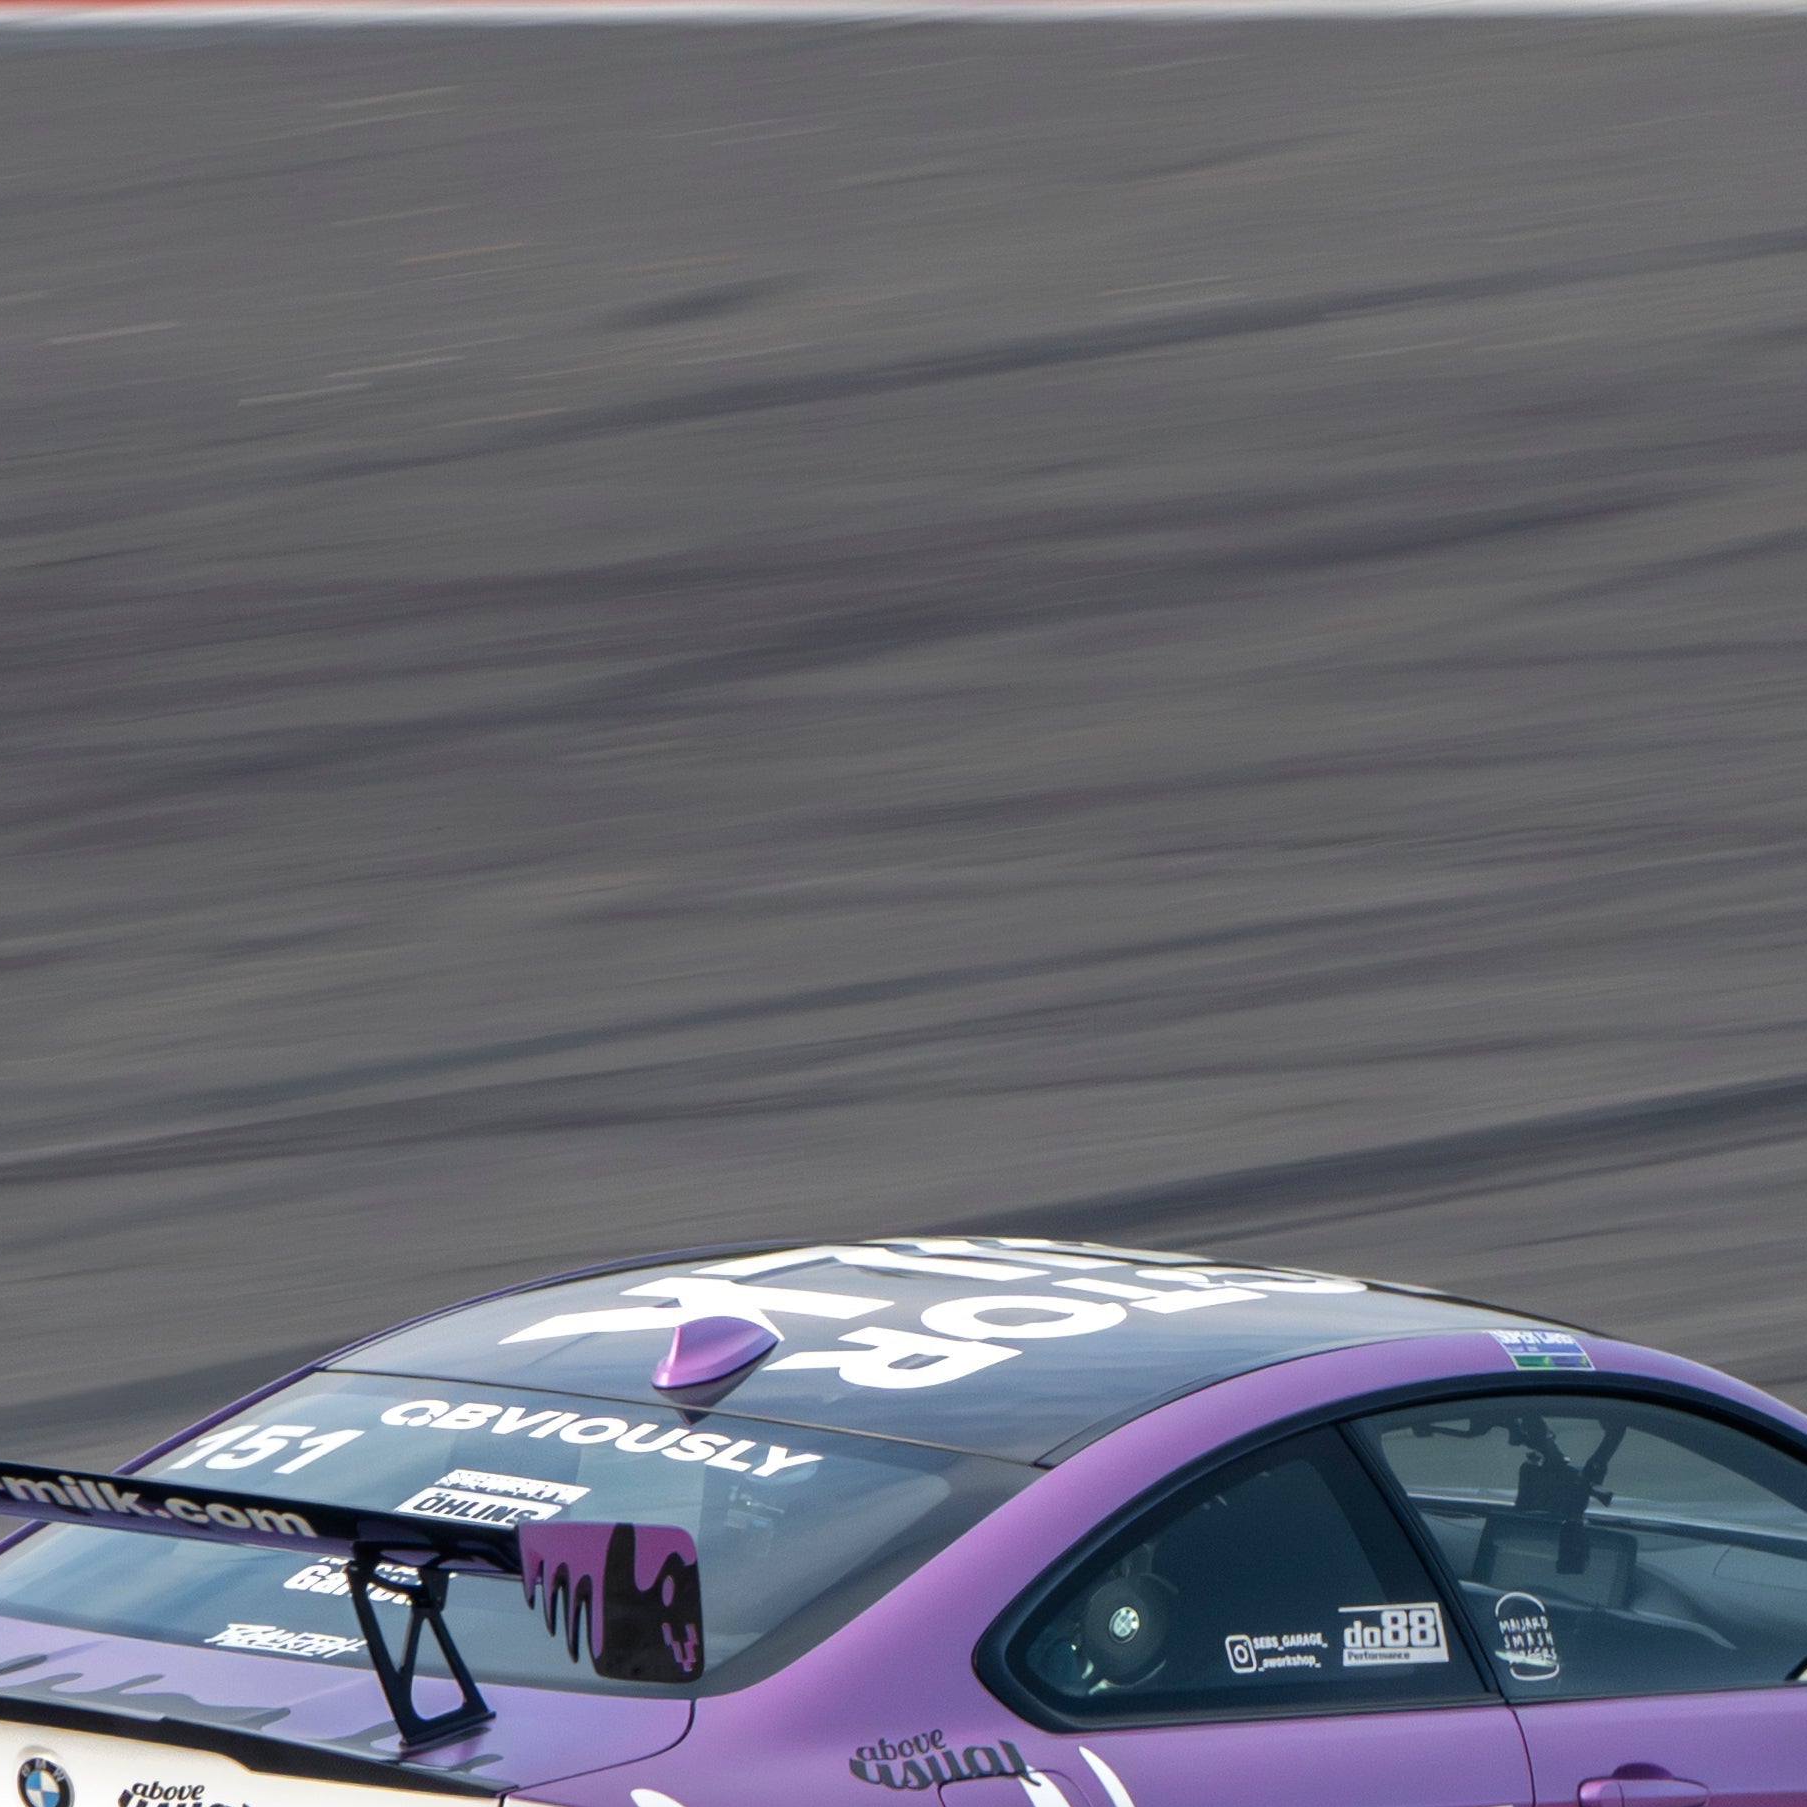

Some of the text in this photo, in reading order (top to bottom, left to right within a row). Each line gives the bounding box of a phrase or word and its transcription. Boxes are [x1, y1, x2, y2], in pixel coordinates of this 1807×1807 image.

[762, 1264, 1371, 1389] OTOR
[171, 1425, 366, 1474] 151
[381, 1400, 824, 1478] OBVIOUSLY
[1344, 1609, 1437, 1648] do88
[1504, 1632, 1554, 1650] SMASH
[849, 1739, 1042, 1791] usual
[855, 1729, 946, 1762] above
[131, 1782, 205, 1802] above
